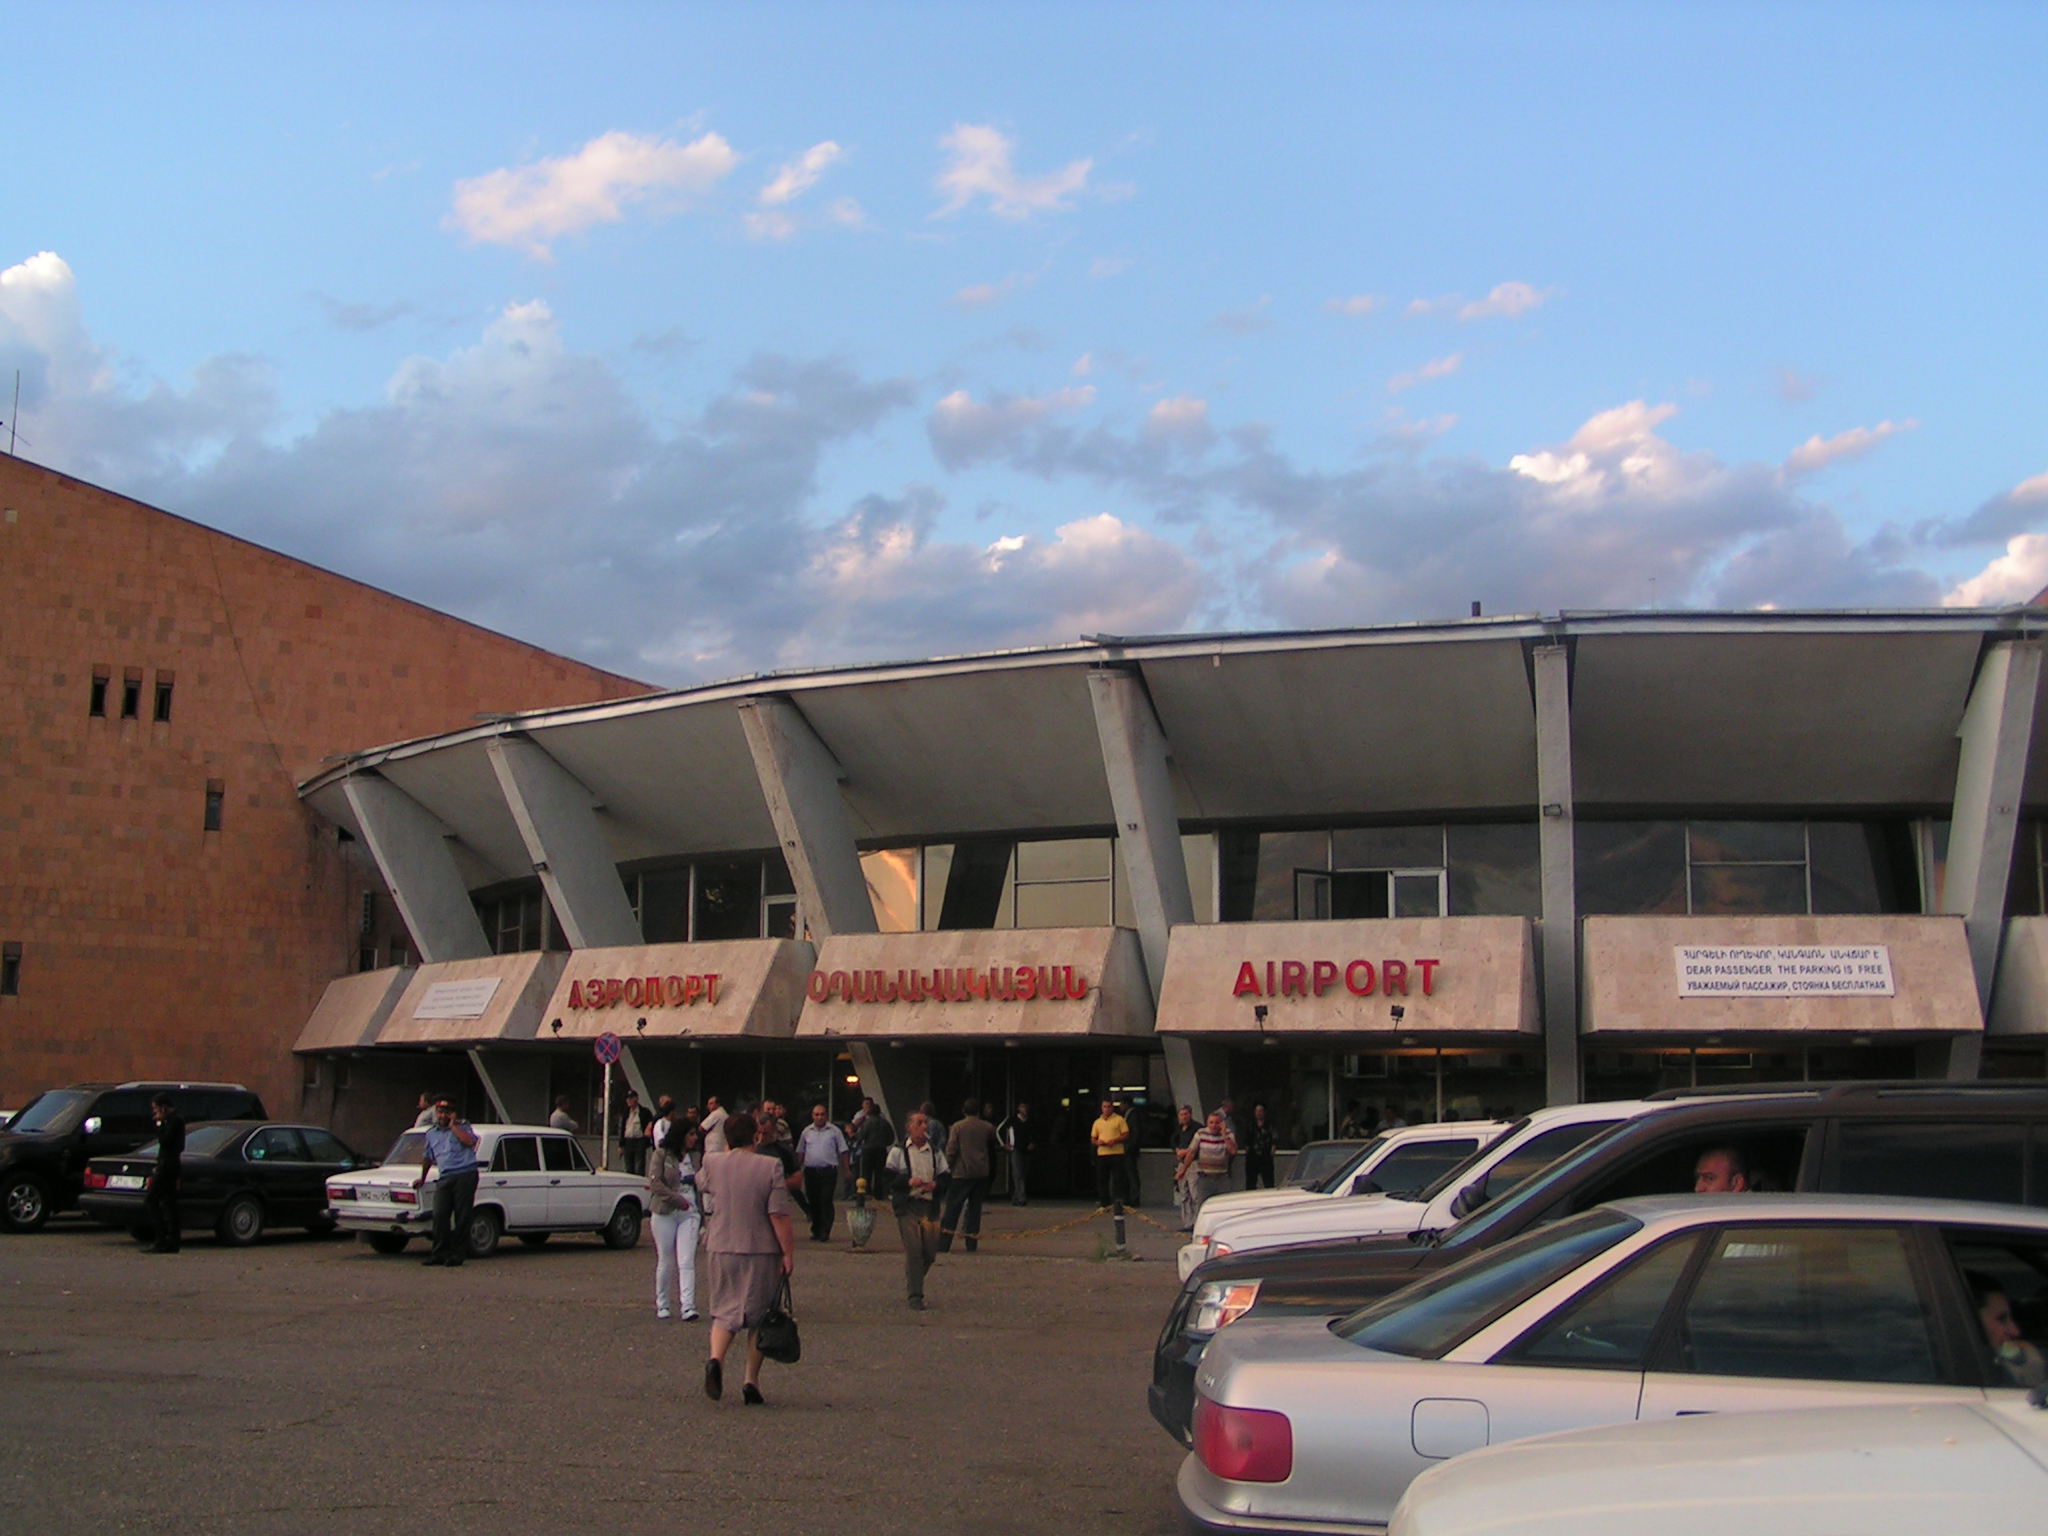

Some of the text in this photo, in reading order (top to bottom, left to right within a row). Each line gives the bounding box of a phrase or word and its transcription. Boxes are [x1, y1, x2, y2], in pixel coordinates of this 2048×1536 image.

[807, 965, 1089, 1003] ՕԴԱՆԱՎԱԿԱՅԱՆ
[1232, 959, 1441, 997] AIRPORT
[1686, 965, 1884, 975] DEAR PASSENGER THE PARKING IS FREE
[1687, 980, 1740, 990] УВАЖАЕМЫЙ
[1792, 981, 1830, 991] СТОЯНКА
[1832, 981, 1887, 991] БЕСПЛАТНАЯ
[567, 973, 720, 1010] АЭРОПОРТ
